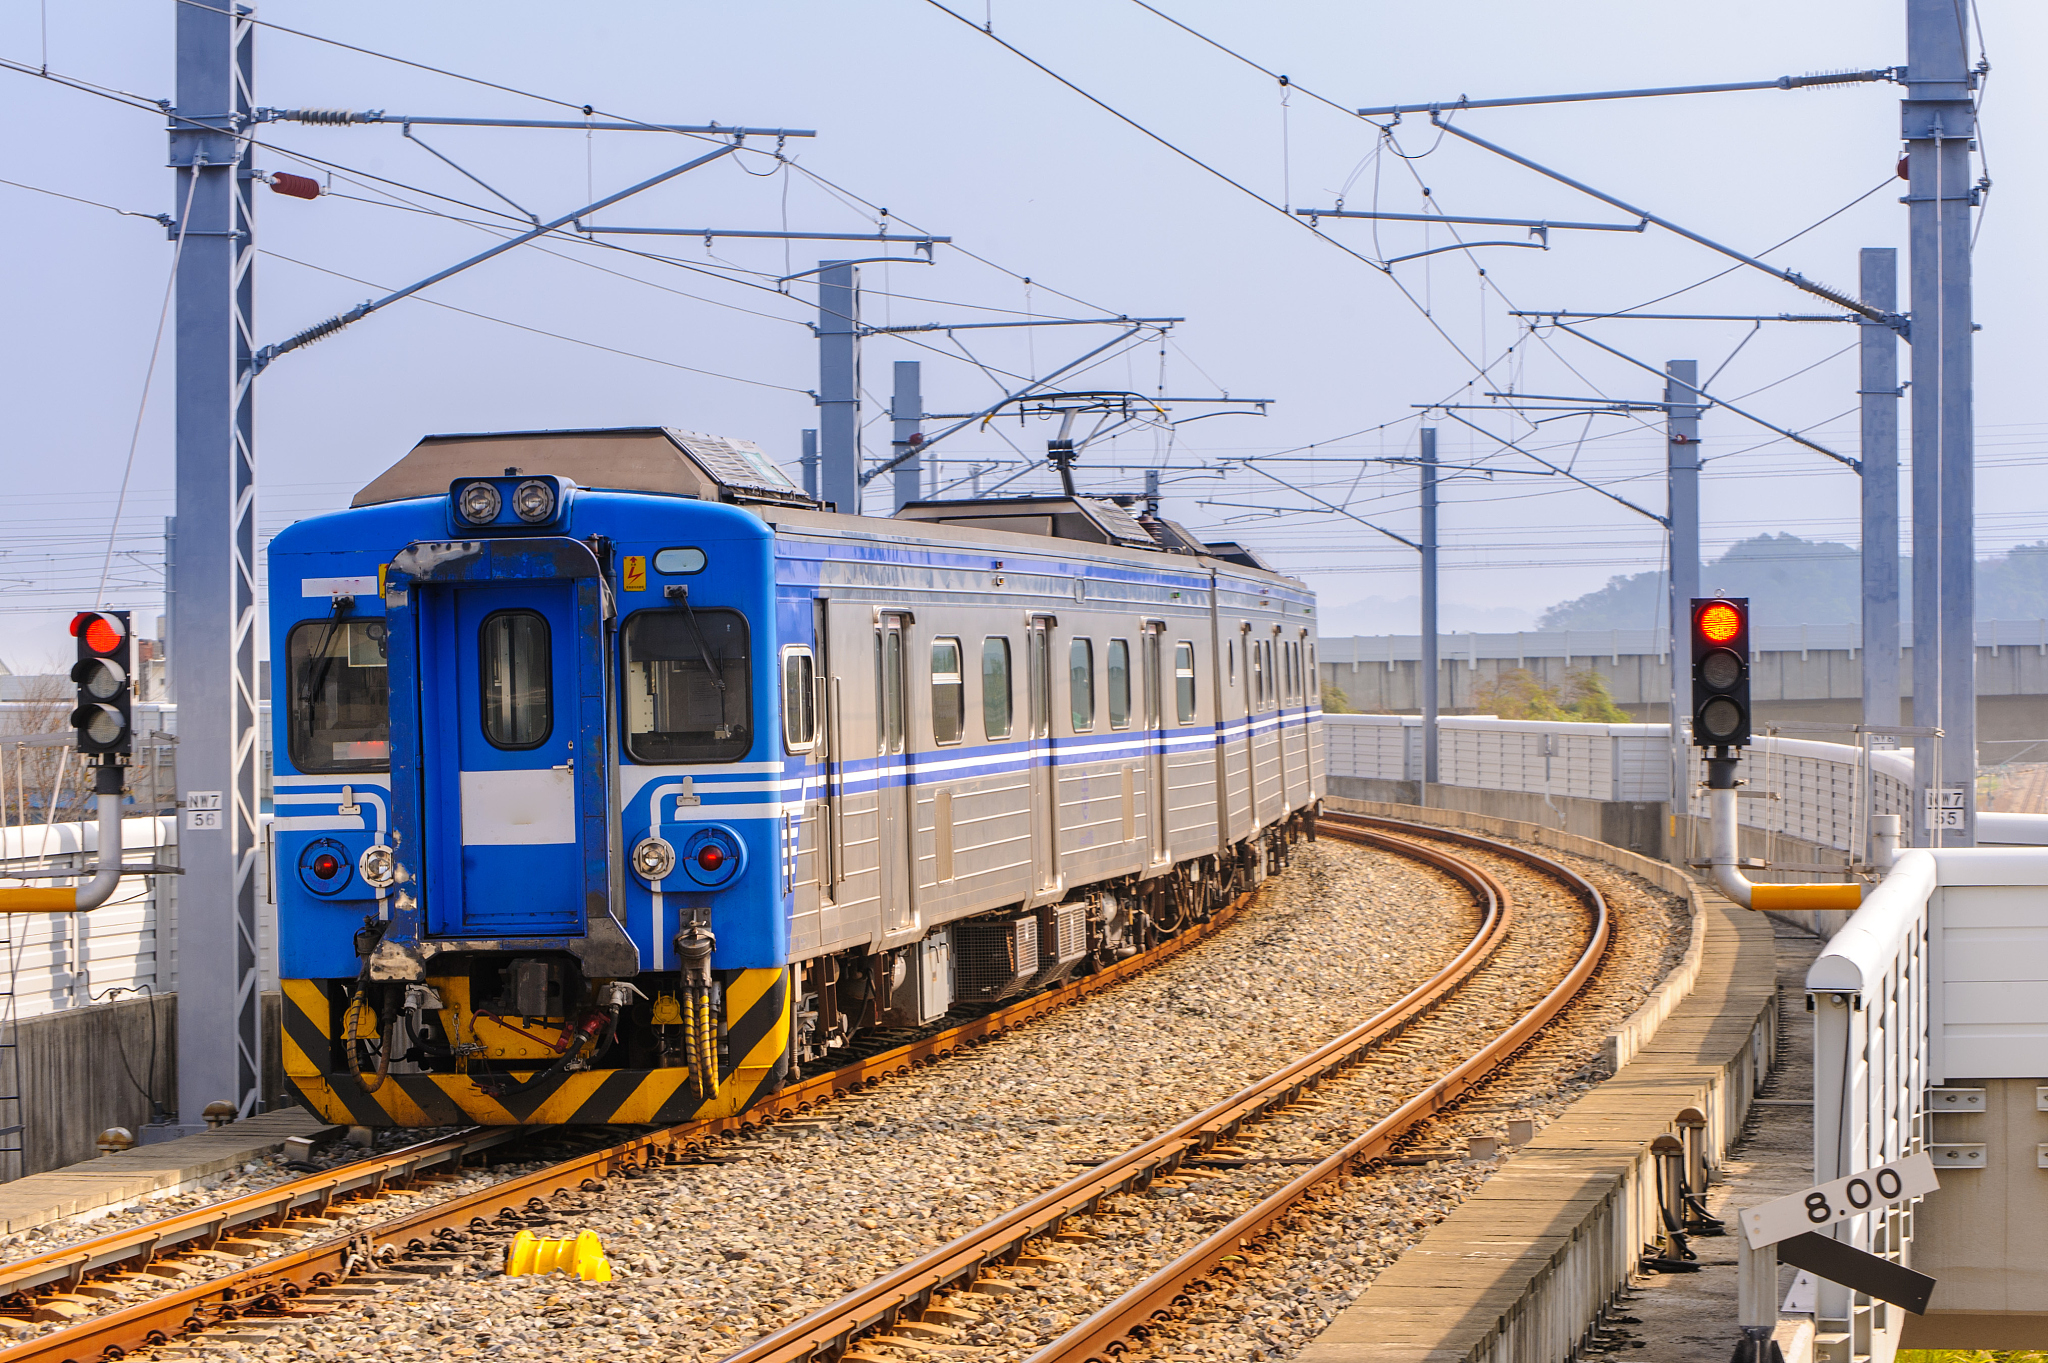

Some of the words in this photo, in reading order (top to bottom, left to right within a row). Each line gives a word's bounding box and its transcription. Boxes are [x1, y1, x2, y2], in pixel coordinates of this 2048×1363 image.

[189, 795, 219, 808] NW7
[194, 813, 215, 826] 56
[1804, 1168, 1902, 1224] 8.00
